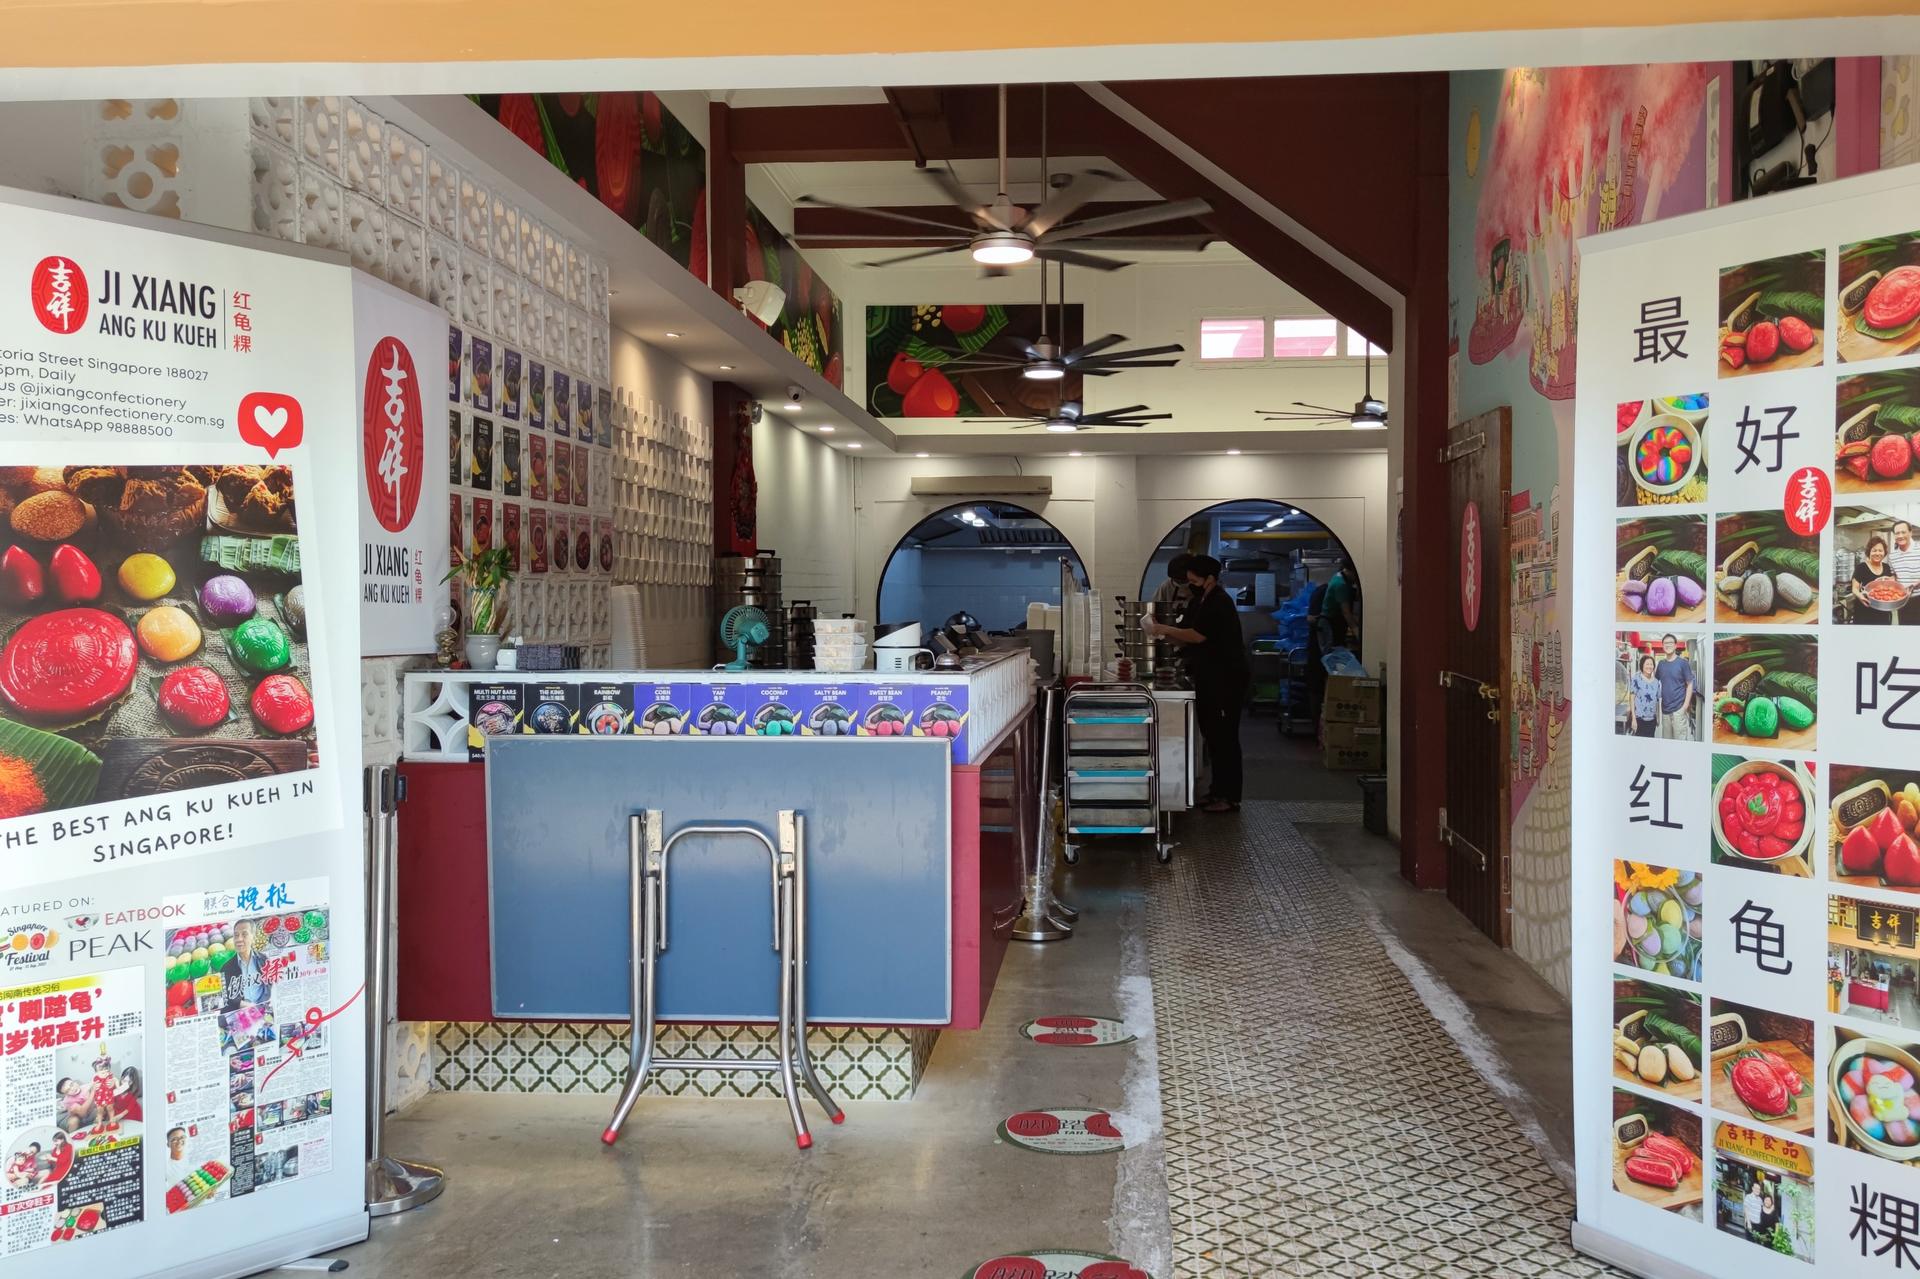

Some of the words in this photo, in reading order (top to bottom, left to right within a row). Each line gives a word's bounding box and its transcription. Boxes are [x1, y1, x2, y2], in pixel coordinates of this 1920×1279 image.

[46, 258, 75, 331] 吉祥
[98, 270, 120, 306] JI
[132, 274, 216, 319] XIANG
[99, 313, 136, 338] ANG
[144, 320, 166, 341] KU
[174, 322, 217, 348] KUEH
[233, 290, 252, 354] 红龟粿
[1633, 296, 1690, 364] 最
[38, 352, 84, 368] Street
[88, 357, 162, 376] Singapore
[166, 366, 208, 381] 188027
[39, 367, 76, 384] Daily
[20, 382, 186, 410] @jixiangconfectionery
[20, 397, 224, 430] jixiangconfectionery.com.sg
[24, 414, 103, 433] WhatsApp
[106, 422, 173, 437] 98888500
[1734, 405, 1800, 475] 好
[1796, 469, 1820, 532] 吉祥
[363, 544, 372, 576] JI
[376, 544, 408, 578] XIANG
[364, 584, 378, 602] ANG
[380, 584, 390, 603] KU
[392, 584, 410, 604] KUEH
[1856, 656, 1920, 731] 吃
[1629, 764, 1683, 830] 红
[0, 828, 38, 850] HE
[52, 816, 110, 841] BEST
[124, 804, 171, 828] ANG
[186, 798, 214, 816] KU
[228, 788, 281, 810] KUEH
[292, 780, 314, 798] IN
[93, 823, 234, 863] SINGAPORE!
[68, 897, 94, 908] ON:
[105, 904, 186, 926] EATBOOK
[69, 929, 154, 962] PEAK
[1728, 900, 1792, 976] 龟
[5, 950, 50, 966] Festival
[0, 1016, 104, 1056] 岁祝高升
[1726, 1140, 1744, 1154] XIANG
[1745, 1148, 1798, 1169] CONFECTIONERY
[1727, 1123, 1799, 1158] 吉祥食品
[1850, 1182, 1920, 1272] 粿
